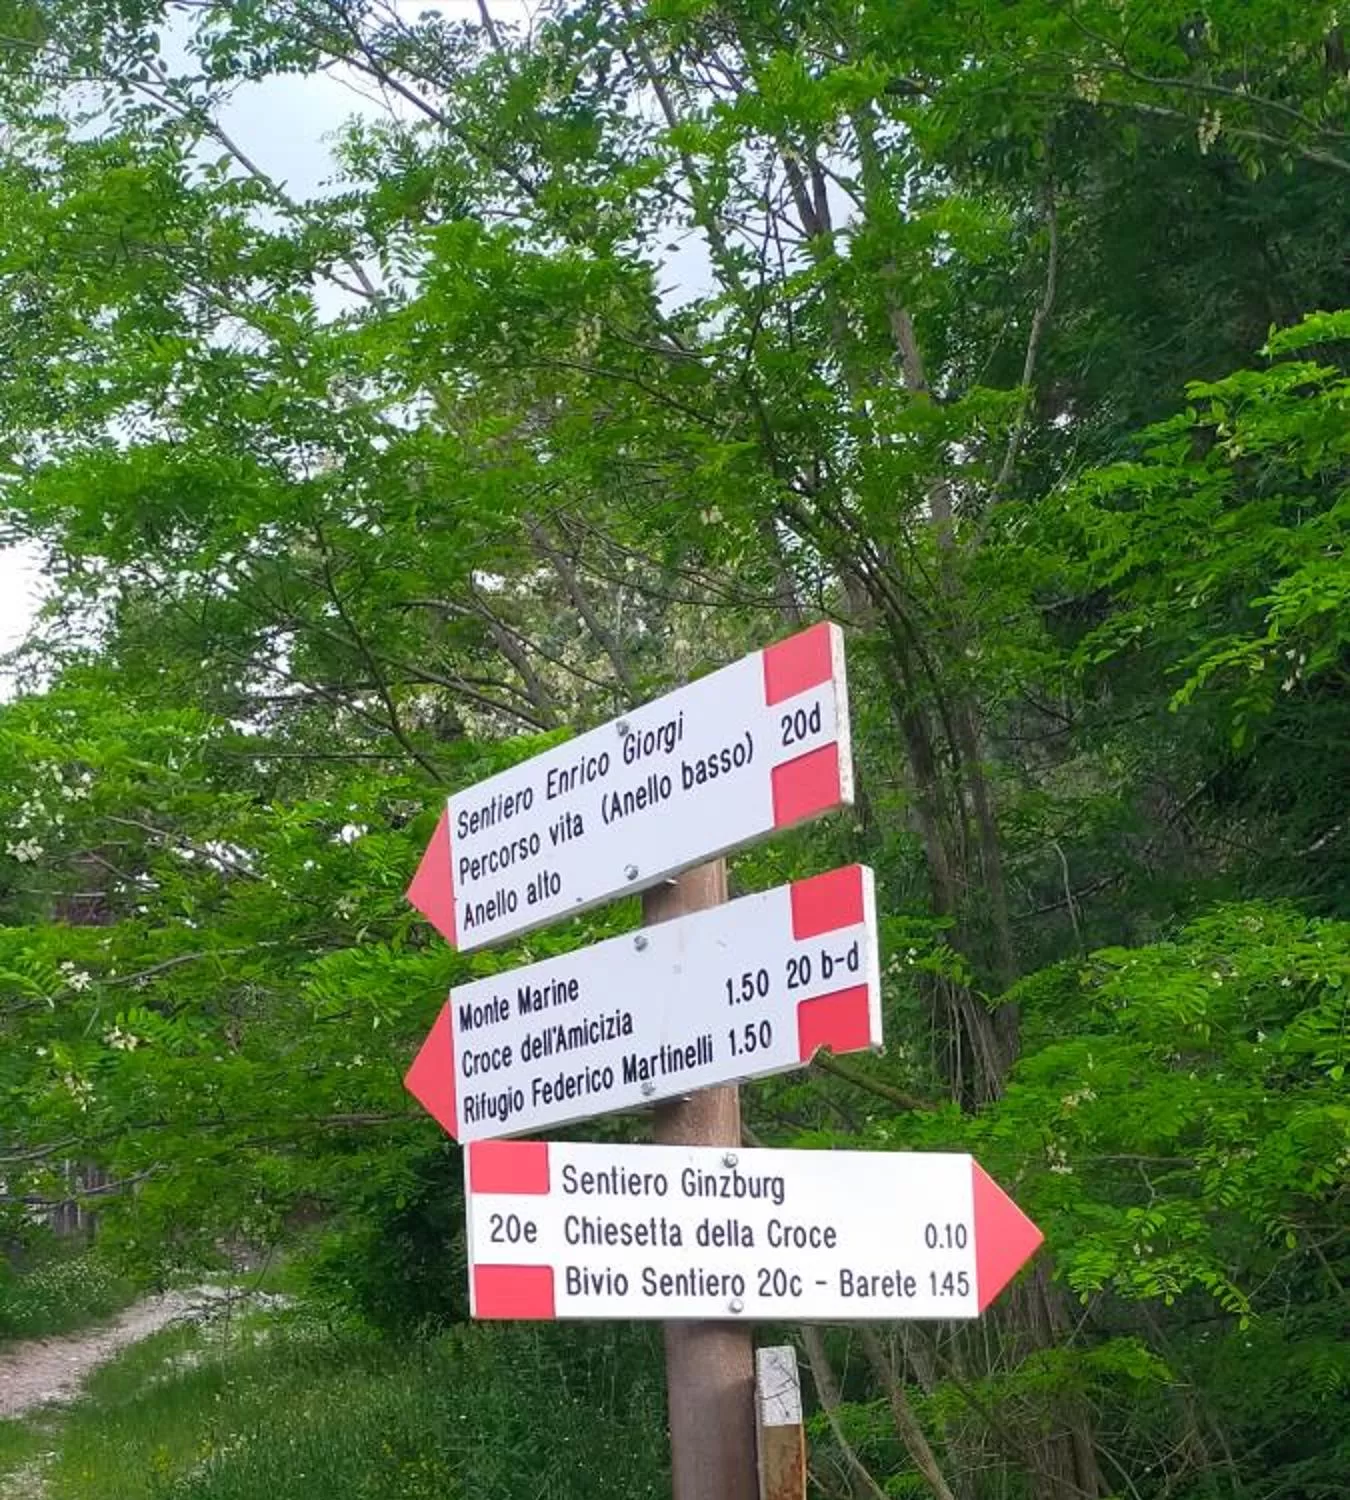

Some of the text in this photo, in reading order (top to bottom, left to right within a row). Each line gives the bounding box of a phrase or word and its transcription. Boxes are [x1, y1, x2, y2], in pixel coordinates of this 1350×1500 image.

[781, 702, 821, 746] 20d
[457, 711, 684, 840] Sentiero Enrico Giorgi
[459, 732, 754, 885] Percorso vita (Anello basso)
[464, 870, 561, 930] Anello alto
[786, 942, 859, 990] 20 b-d
[459, 979, 579, 1032] Monte Marine
[463, 969, 769, 1078] Croce dell'Amicizia 1.50
[464, 1020, 772, 1127] Rifugio Federico Martinelli 1.50
[562, 1166, 785, 1204] Sentiero Ginzburg
[490, 1214, 538, 1244] 20e
[564, 1215, 967, 1250] Chiesetta della Croce 0.10
[567, 1266, 629, 1296] Bivio
[642, 1268, 746, 1298] Sentiero
[758, 1269, 802, 1297] 20c
[840, 1271, 916, 1298] Barete
[930, 1272, 969, 1296] 1.45
